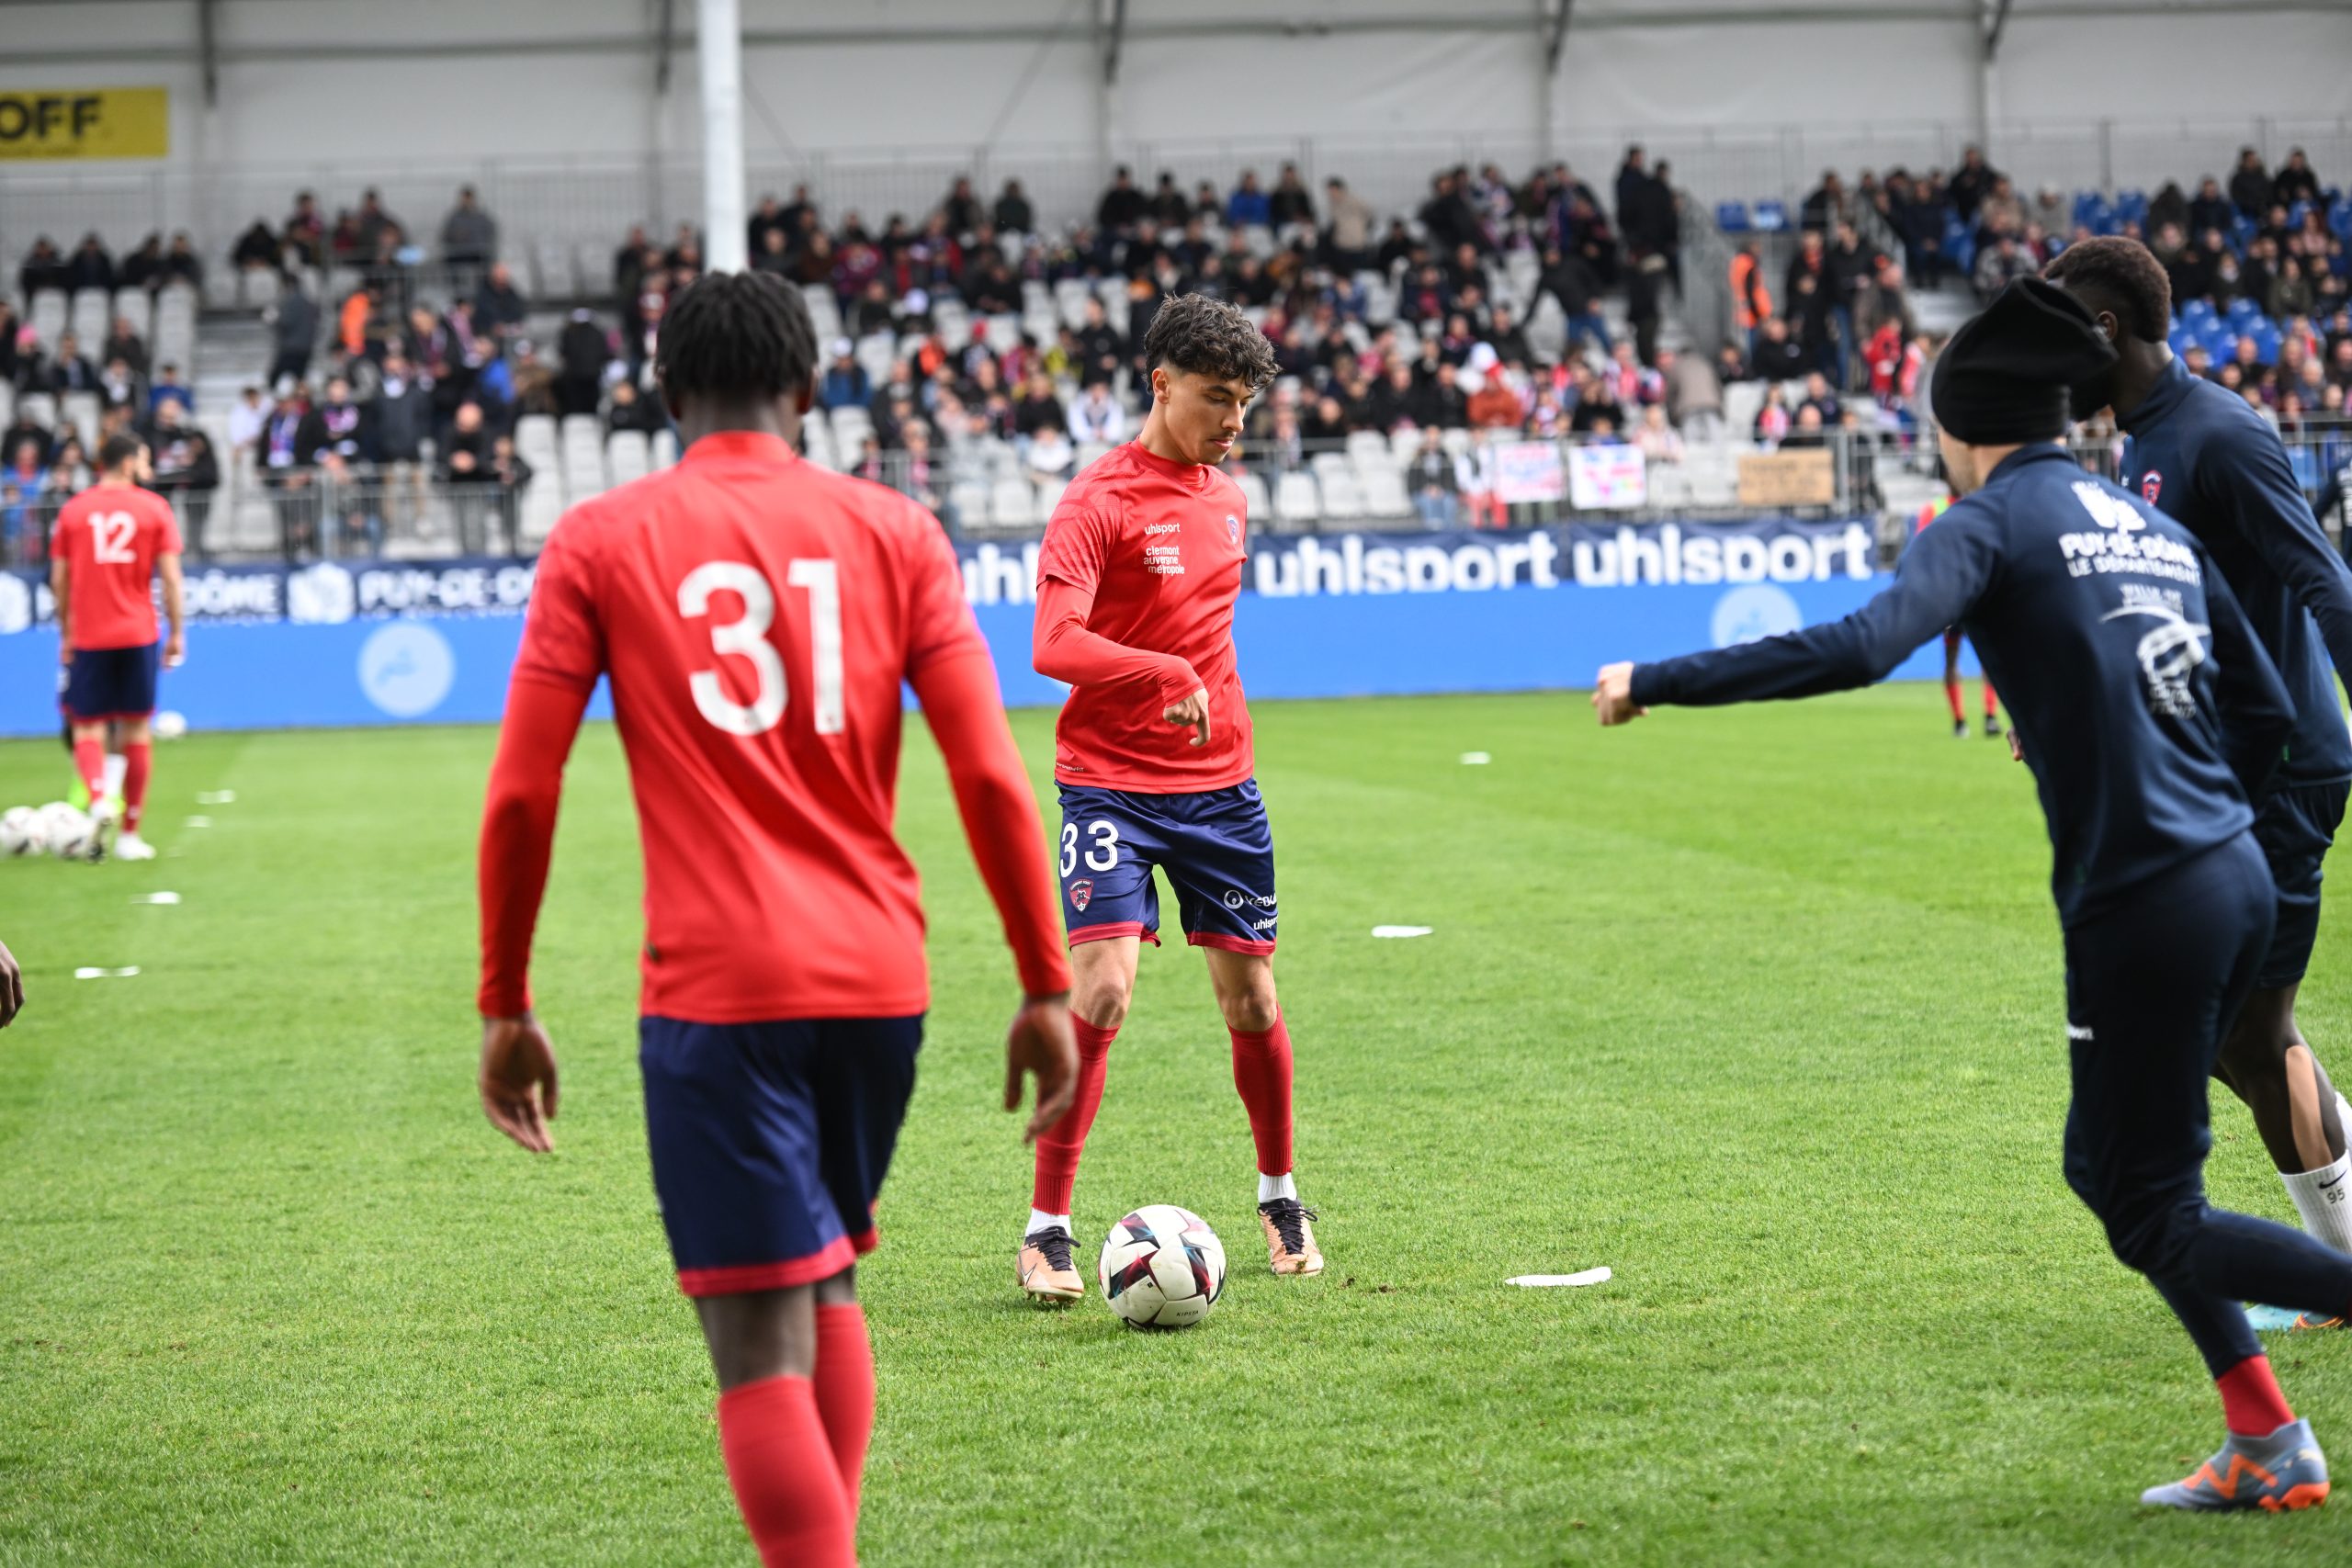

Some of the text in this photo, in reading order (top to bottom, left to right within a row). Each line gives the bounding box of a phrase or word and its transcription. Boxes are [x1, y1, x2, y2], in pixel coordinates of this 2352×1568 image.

[87, 510, 137, 564] 12
[1144, 523, 1181, 535] uhlsport
[1146, 546, 1180, 556] clermont
[1255, 522, 1873, 597] uhlsport uhlsport
[1143, 556, 1179, 565] auvergne
[1148, 564, 1185, 577] métropole
[677, 558, 845, 736] 31
[1059, 819, 1119, 878] 33
[2327, 1187, 2346, 1204] 95
